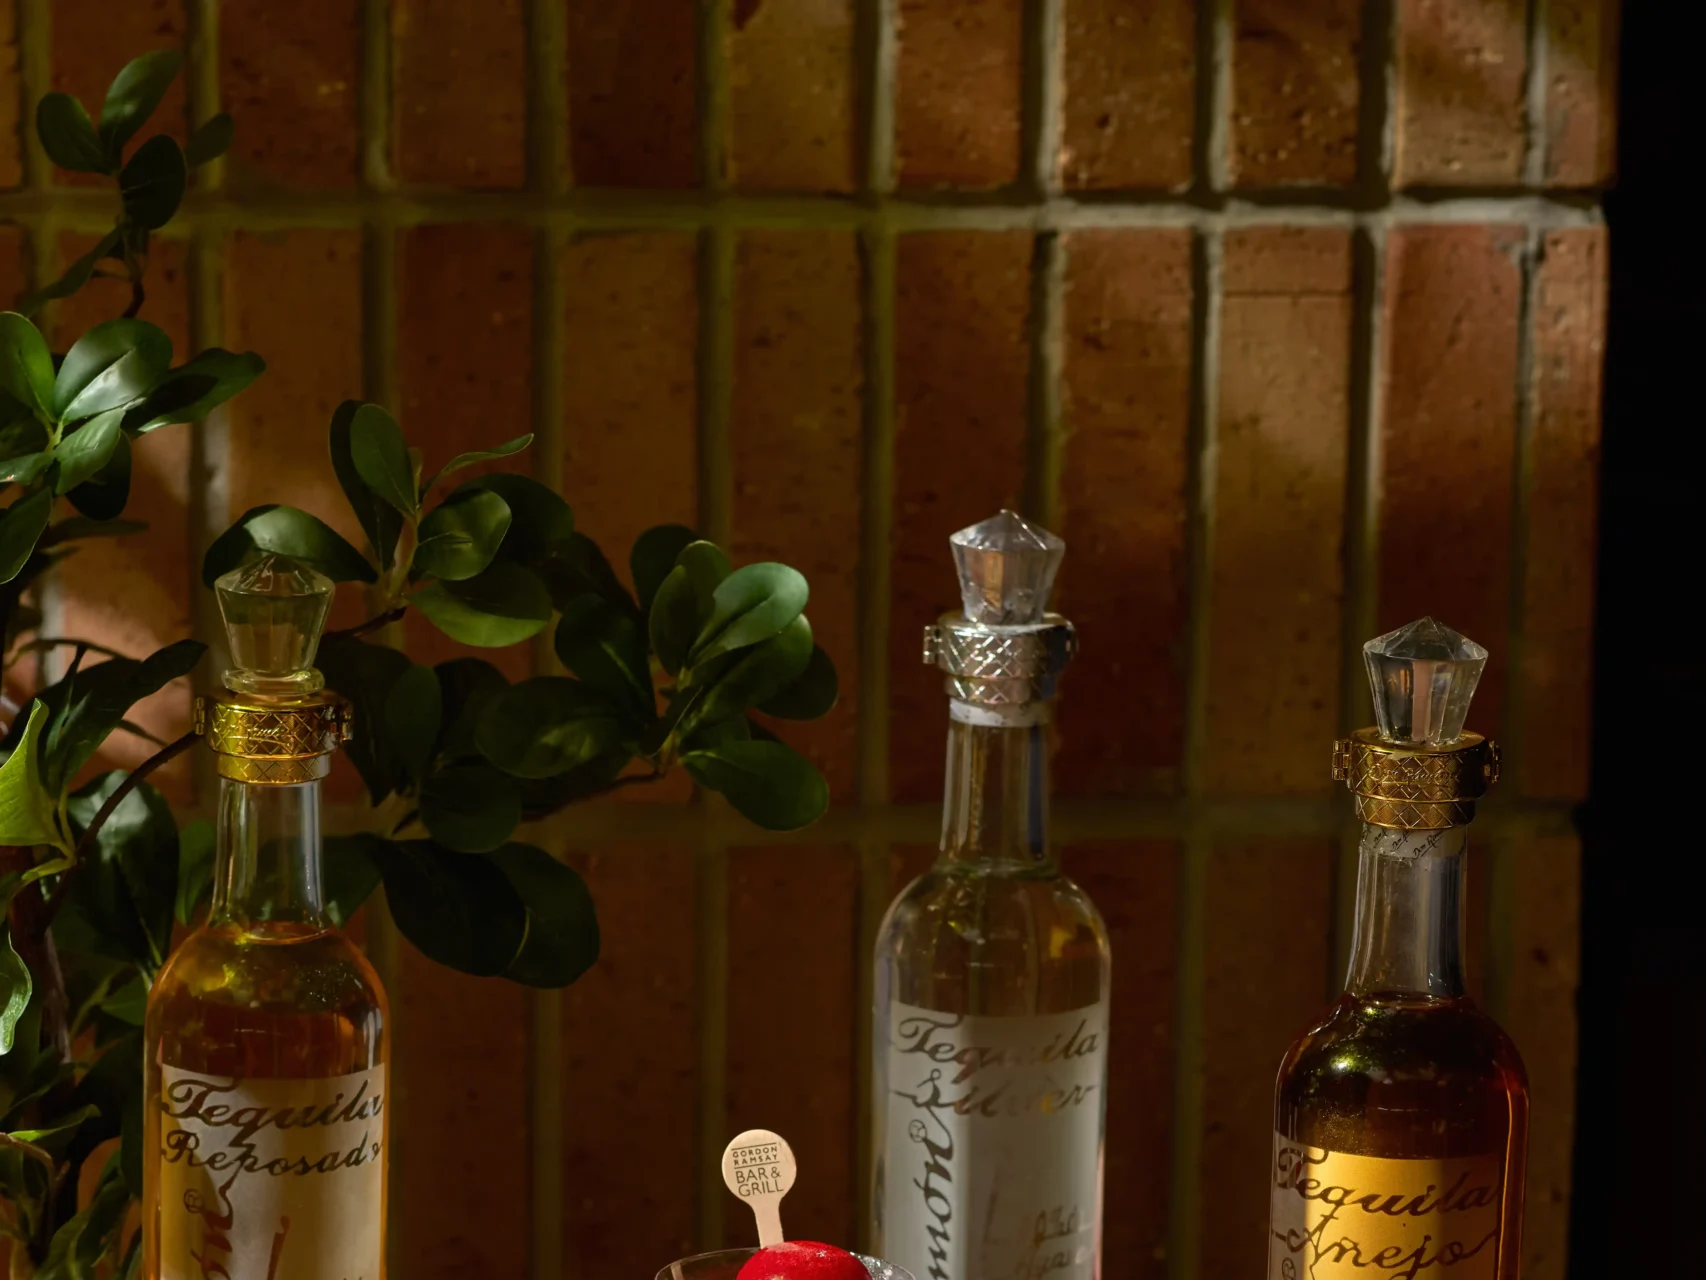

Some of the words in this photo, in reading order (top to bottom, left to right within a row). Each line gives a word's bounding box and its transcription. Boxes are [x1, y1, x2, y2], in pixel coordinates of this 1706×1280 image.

[161, 1077, 383, 1148] Tequila
[161, 1129, 382, 1177] Reposado
[732, 1146, 778, 1158] GORDON
[733, 1154, 778, 1166] RAMSAY
[735, 1167, 768, 1184] BAR
[770, 1166, 782, 1179] &
[1276, 1147, 1498, 1216] Tequila
[738, 1180, 785, 1197] GRILL
